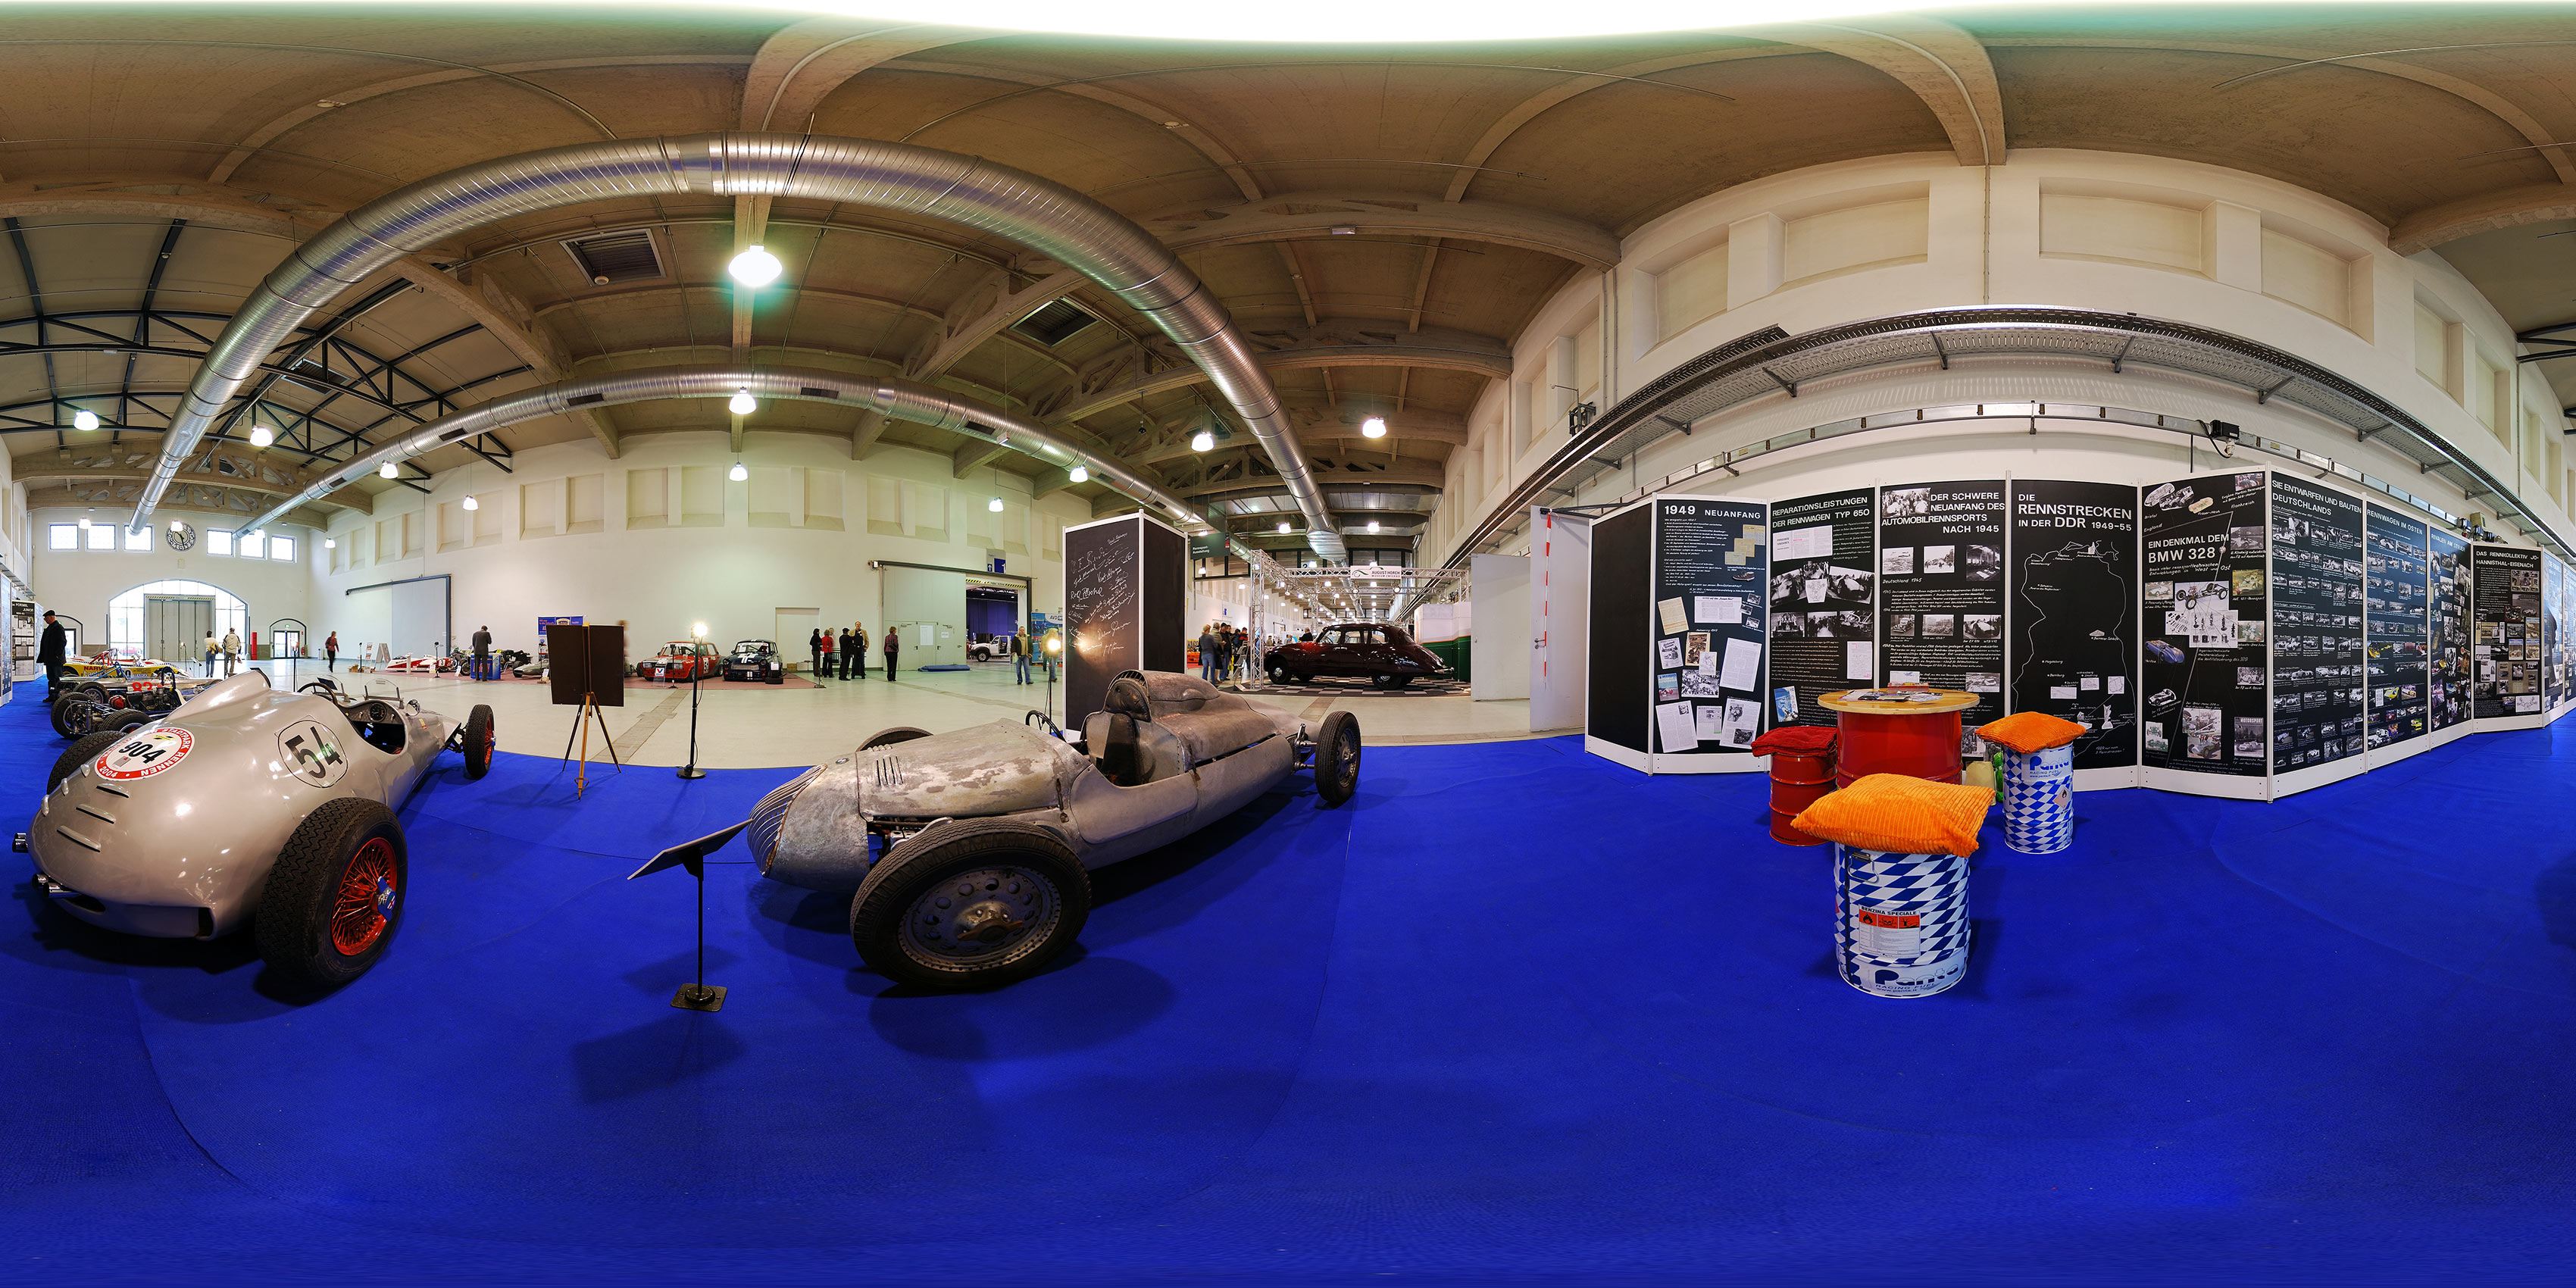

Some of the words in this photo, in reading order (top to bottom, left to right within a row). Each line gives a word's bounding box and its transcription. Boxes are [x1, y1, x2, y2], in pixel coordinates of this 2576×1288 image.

[1952, 492, 1999, 501] SCHWERE
[2271, 480, 2284, 490] SIE
[2284, 483, 2324, 502] ENTWARFEN
[2324, 496, 2338, 506] UND
[2339, 501, 2362, 514] BAUTEN
[2272, 492, 2331, 516] DEUTSCHLANDS
[1665, 505, 1696, 515] 1949
[1705, 509, 1761, 519] NEUANFANG
[1772, 497, 1868, 517] REPARATIONSLEISTUNGEN
[1930, 503, 1985, 511] NEUANFANG
[2018, 504, 2132, 520] RENNSTRECKEN
[1787, 514, 1830, 525] RENNWAGEN
[1853, 508, 1870, 517] 650
[1881, 514, 1987, 527] AUTOMOBILRENNSPORTS
[2055, 517, 2086, 528] DDR
[2091, 522, 2132, 531] 1949-55
[2367, 509, 2400, 527] RENNWAGEN
[2407, 524, 2423, 535] OSTEN
[1943, 525, 1971, 533] NACH
[2148, 540, 2162, 549] EIN
[2163, 536, 2206, 547] DENKMAL
[2208, 533, 2230, 542] DEM
[2149, 549, 2184, 563] BMW
[2188, 547, 2215, 560] 328
[2476, 560, 2534, 568] HANNISTHAL-EISENACH
[161, 727, 192, 749] STADTPARK
[118, 741, 167, 764] 904
[284, 726, 344, 779] 54
[99, 765, 118, 778] 2004
[141, 752, 183, 777] RENNEN
[1861, 905, 1886, 915] BENZINA
